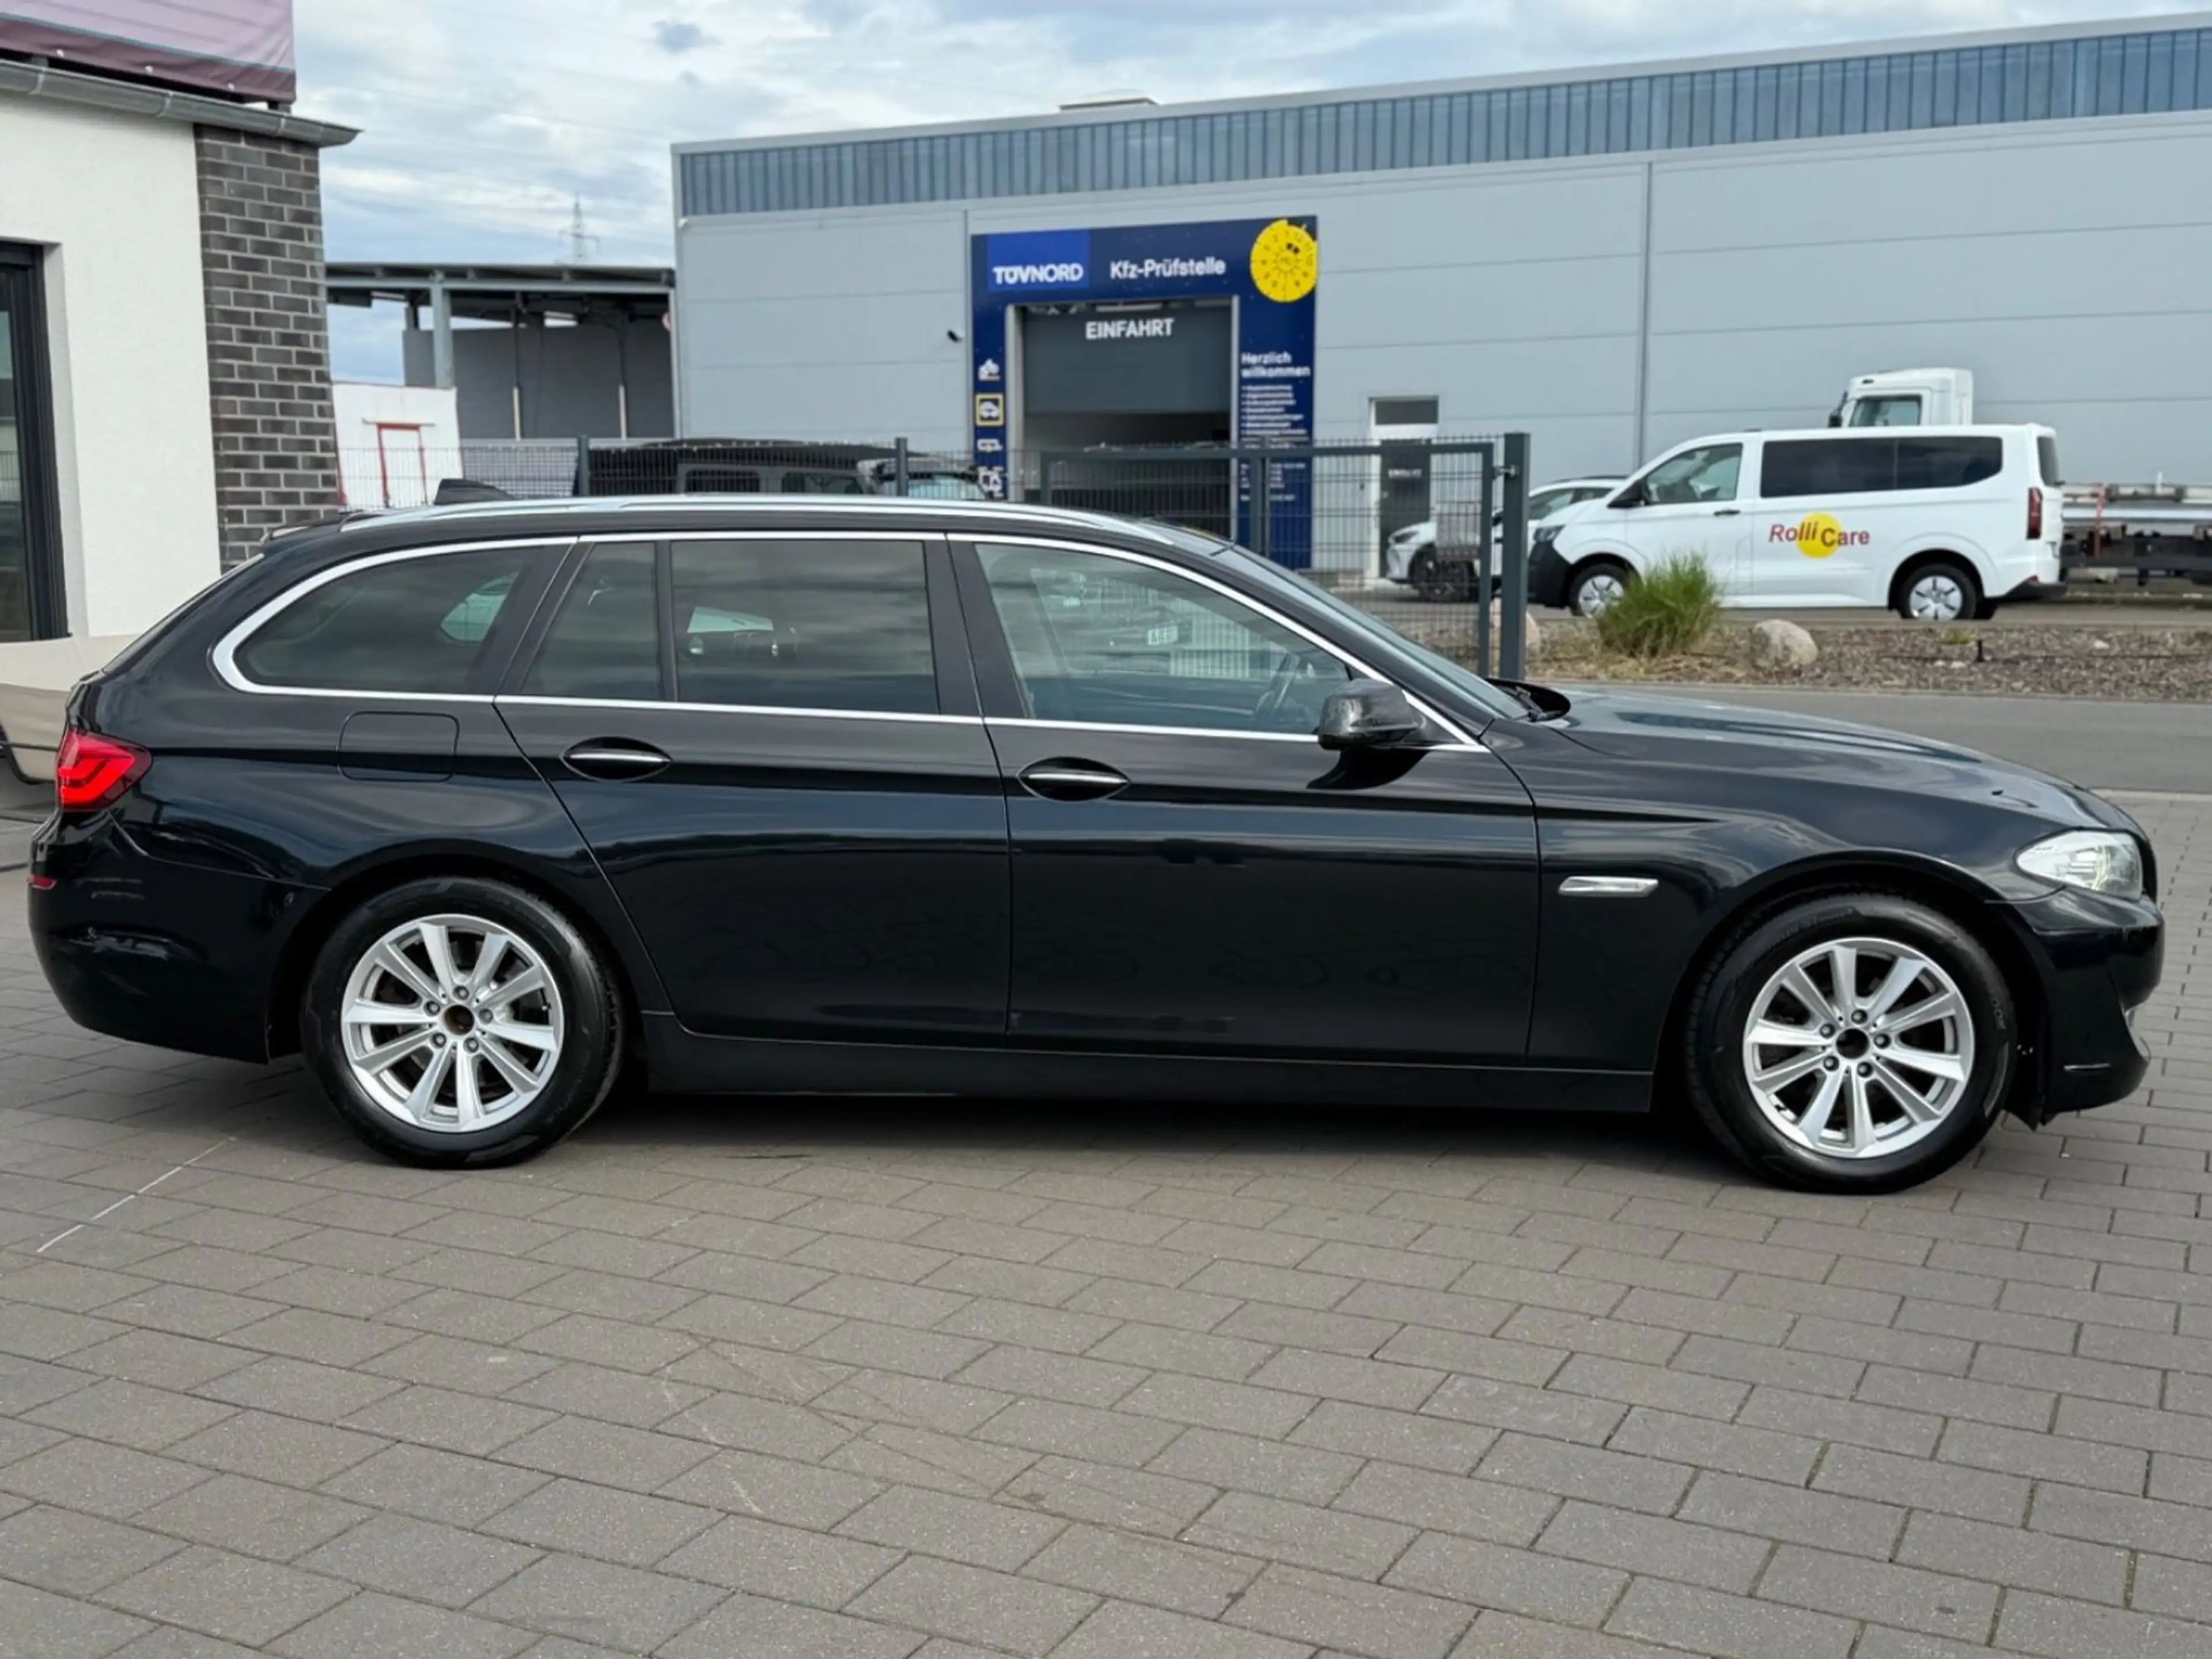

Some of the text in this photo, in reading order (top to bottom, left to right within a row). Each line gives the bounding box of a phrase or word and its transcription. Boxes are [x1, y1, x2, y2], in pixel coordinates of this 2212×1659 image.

[1110, 256, 1226, 279] Kfz-Prüfstelle
[1086, 317, 1175, 340] EINFAHRT
[1241, 351, 1292, 365] Herzlich
[1768, 521, 1870, 548] Rolli Care
